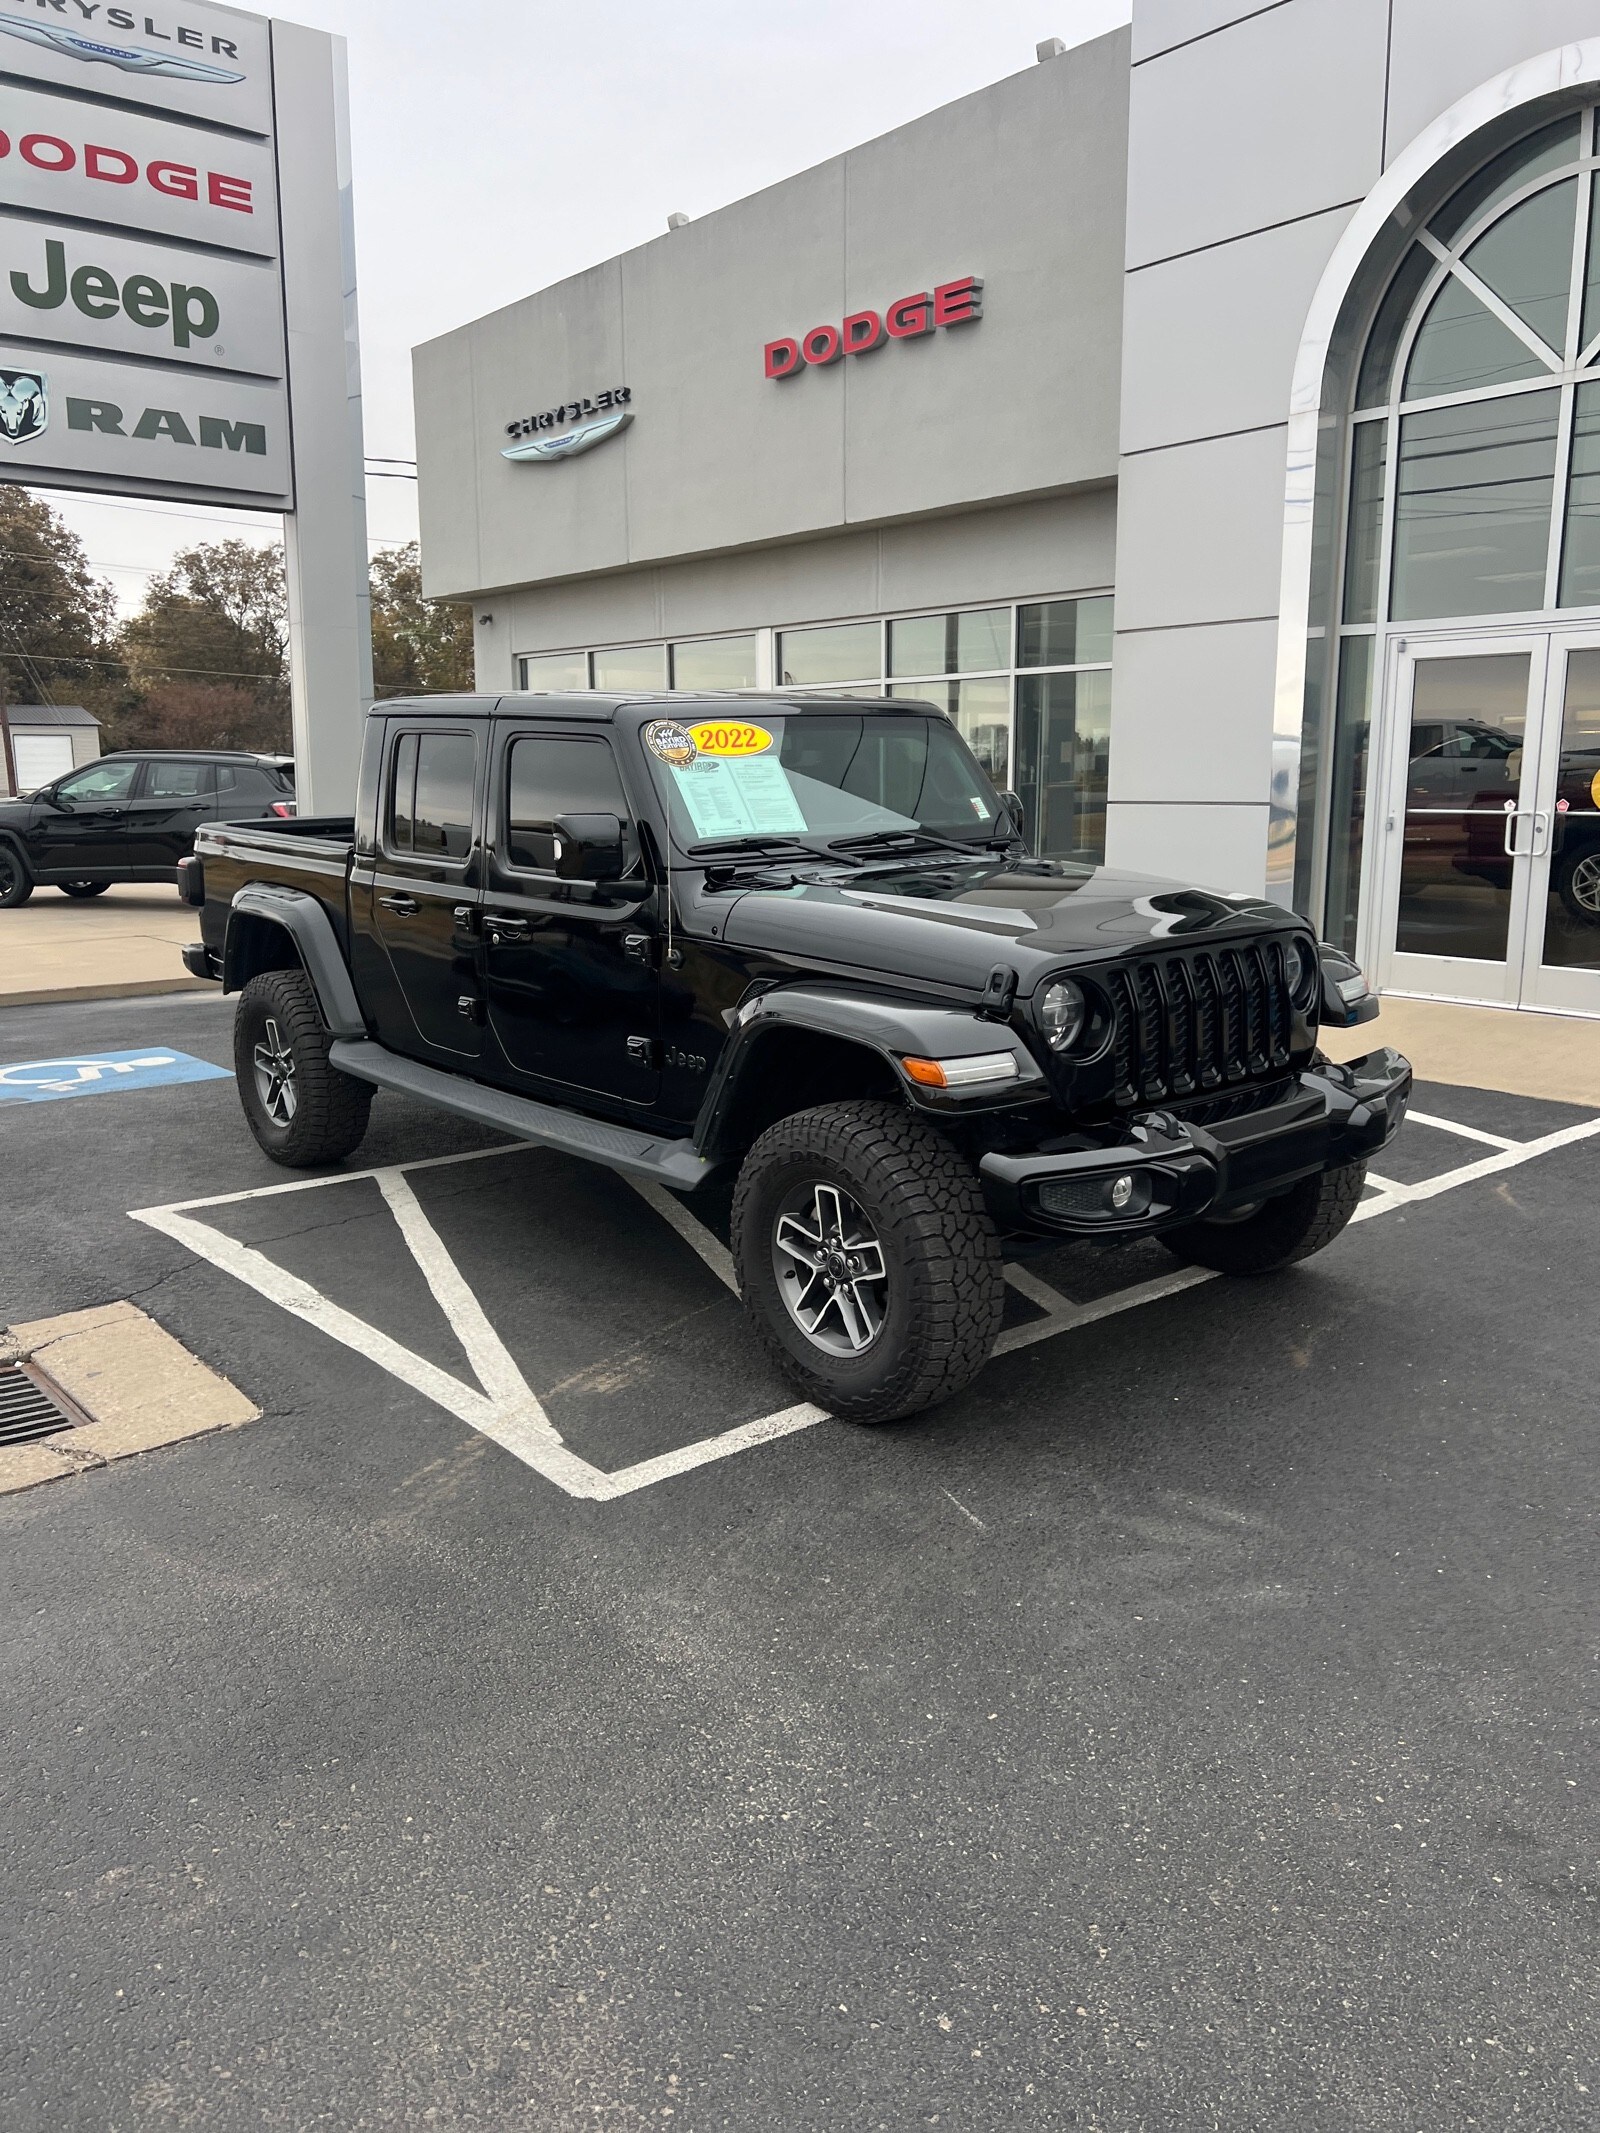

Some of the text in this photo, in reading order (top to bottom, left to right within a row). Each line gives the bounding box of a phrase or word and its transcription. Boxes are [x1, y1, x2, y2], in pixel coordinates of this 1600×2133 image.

[0, 129, 253, 214] ODGE
[9, 238, 220, 349] Jeep
[764, 276, 984, 380] DODGE
[66, 396, 267, 457] RAM
[504, 386, 631, 439] CHRYSLER
[655, 735, 687, 746] BAYIRD
[700, 728, 757, 750] 2022
[665, 1046, 706, 1073] Jeep
